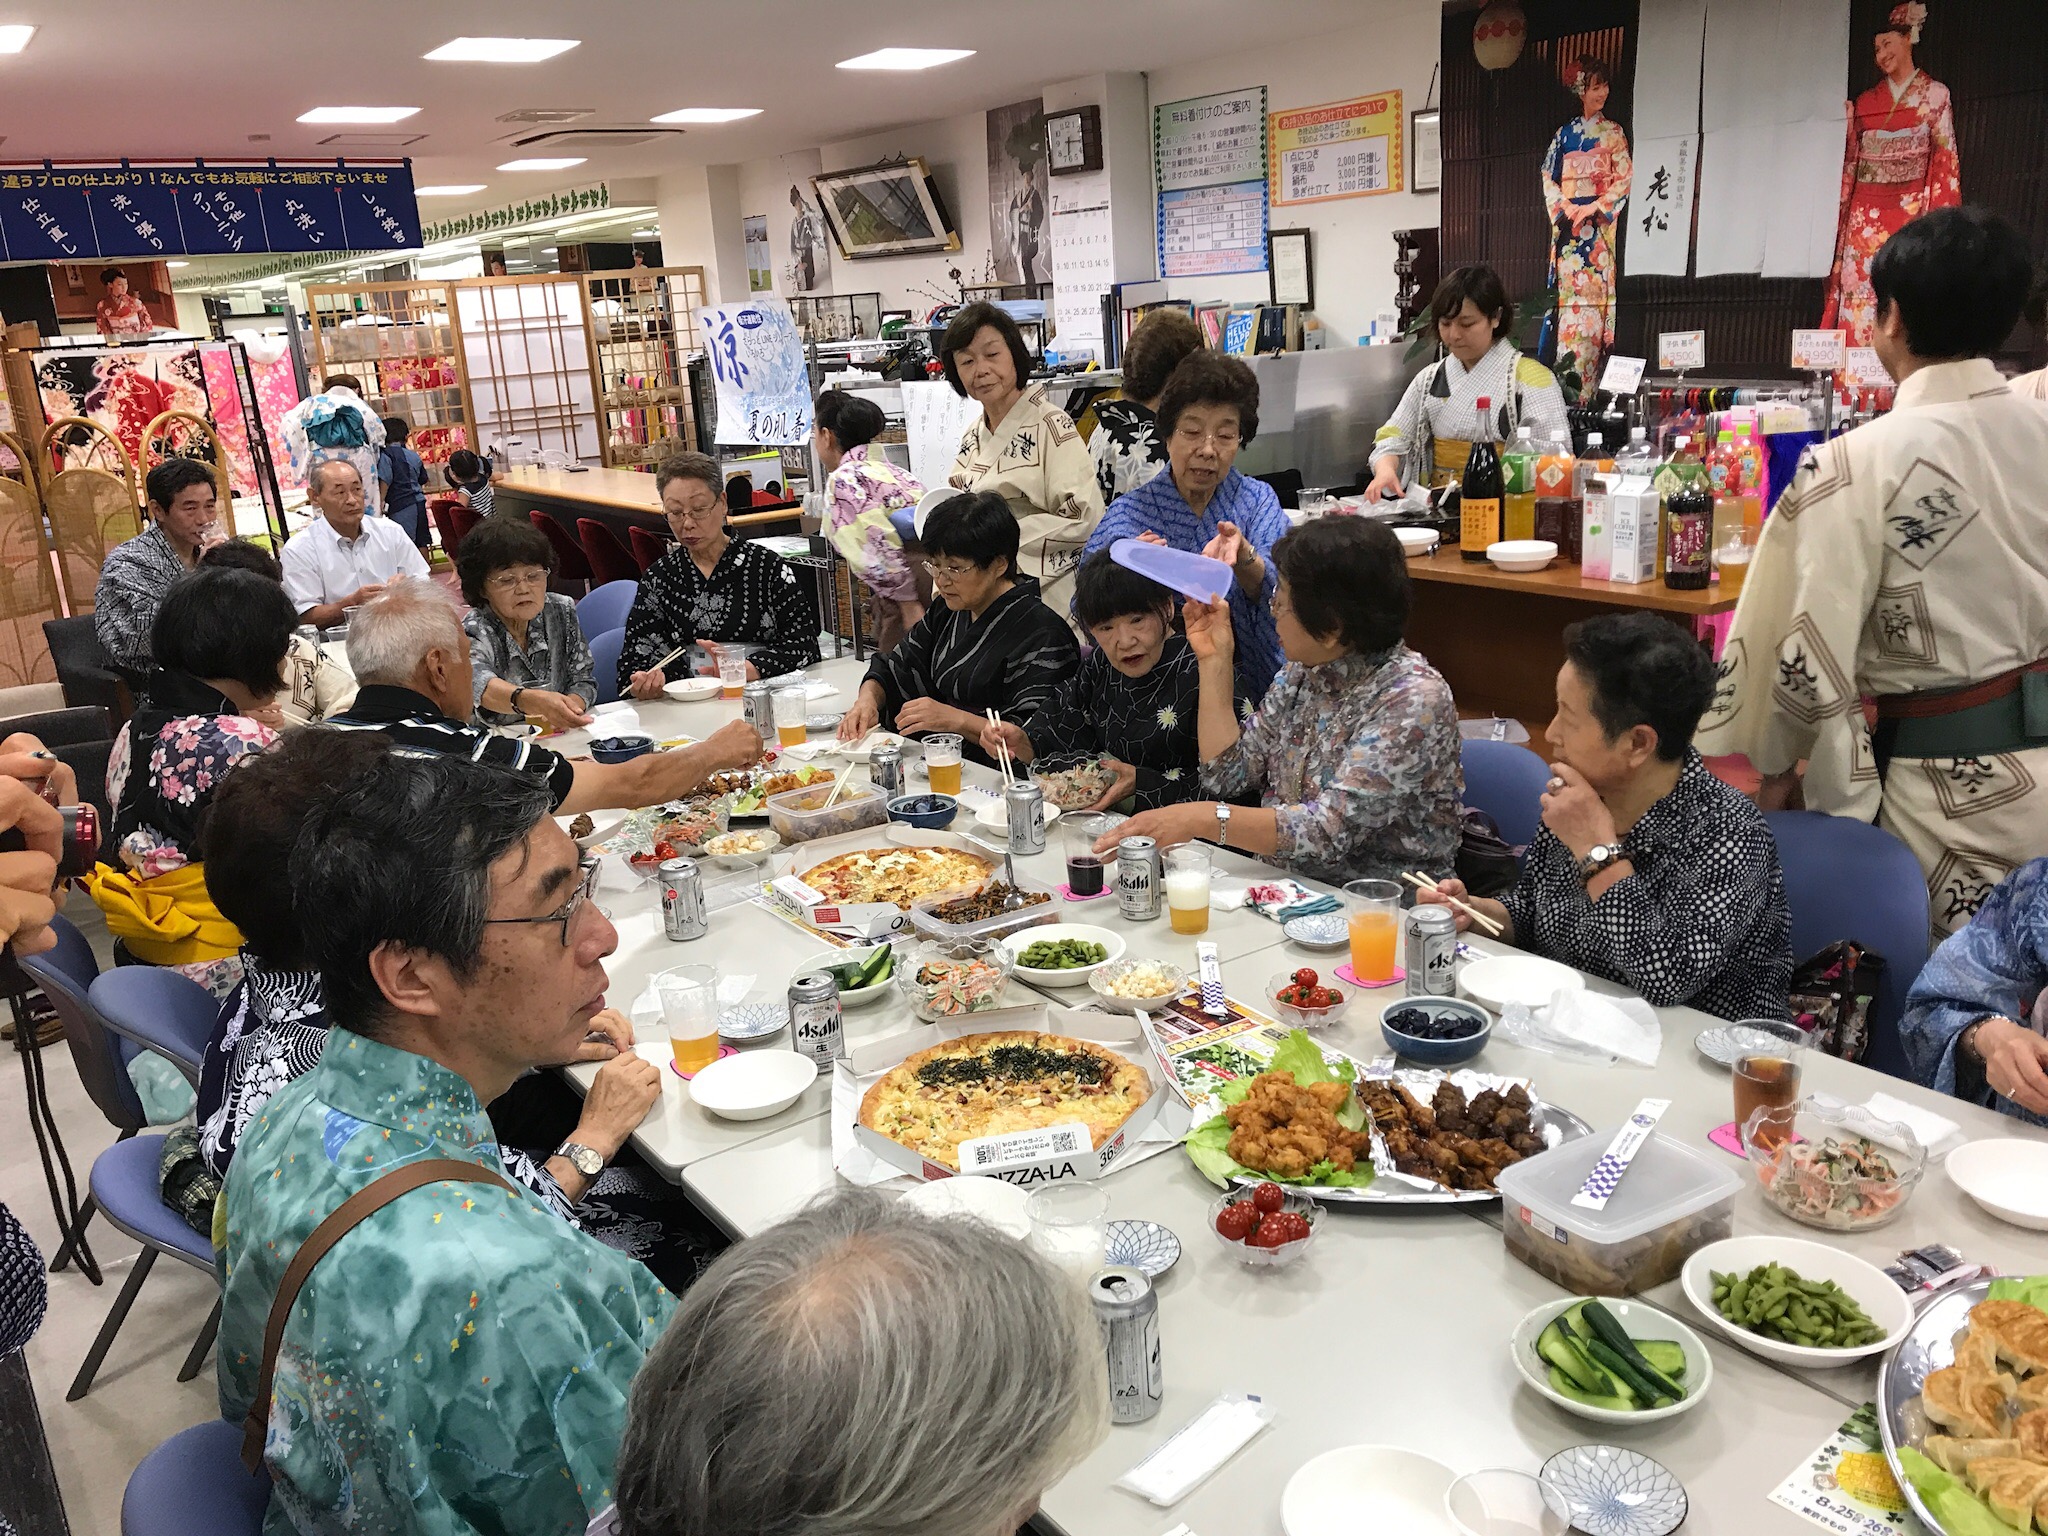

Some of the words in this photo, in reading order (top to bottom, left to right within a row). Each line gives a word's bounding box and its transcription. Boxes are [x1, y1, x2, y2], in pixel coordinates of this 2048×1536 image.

[1171, 100, 1251, 125] 無料着付けのご案内
[1281, 101, 1384, 128] お持込品のお仕立てについて
[1291, 161, 1315, 174] 実用品
[1053, 195, 1058, 210] 7
[1069, 201, 1078, 209] 2017
[1292, 184, 1330, 198] 急ぎ仕立て
[214, 190, 246, 222] その他
[21, 197, 77, 255] 仕立直し
[110, 194, 164, 250] 洗い張り
[192, 191, 244, 251] クリーニング
[285, 199, 326, 244] 丸洗い
[1227, 321, 1253, 338] HELLO
[704, 310, 749, 390] 涼
[748, 408, 805, 442] 夏の肌着
[1674, 533, 1682, 563] 赤ワイン
[1695, 520, 1704, 551] おいしい
[798, 1013, 840, 1038] Asahi
[816, 1043, 829, 1053] 生
[977, 1145, 987, 1165] 100%
[1100, 1145, 1113, 1167] 36
[1801, 1506, 1848, 1533] 東京きもの
